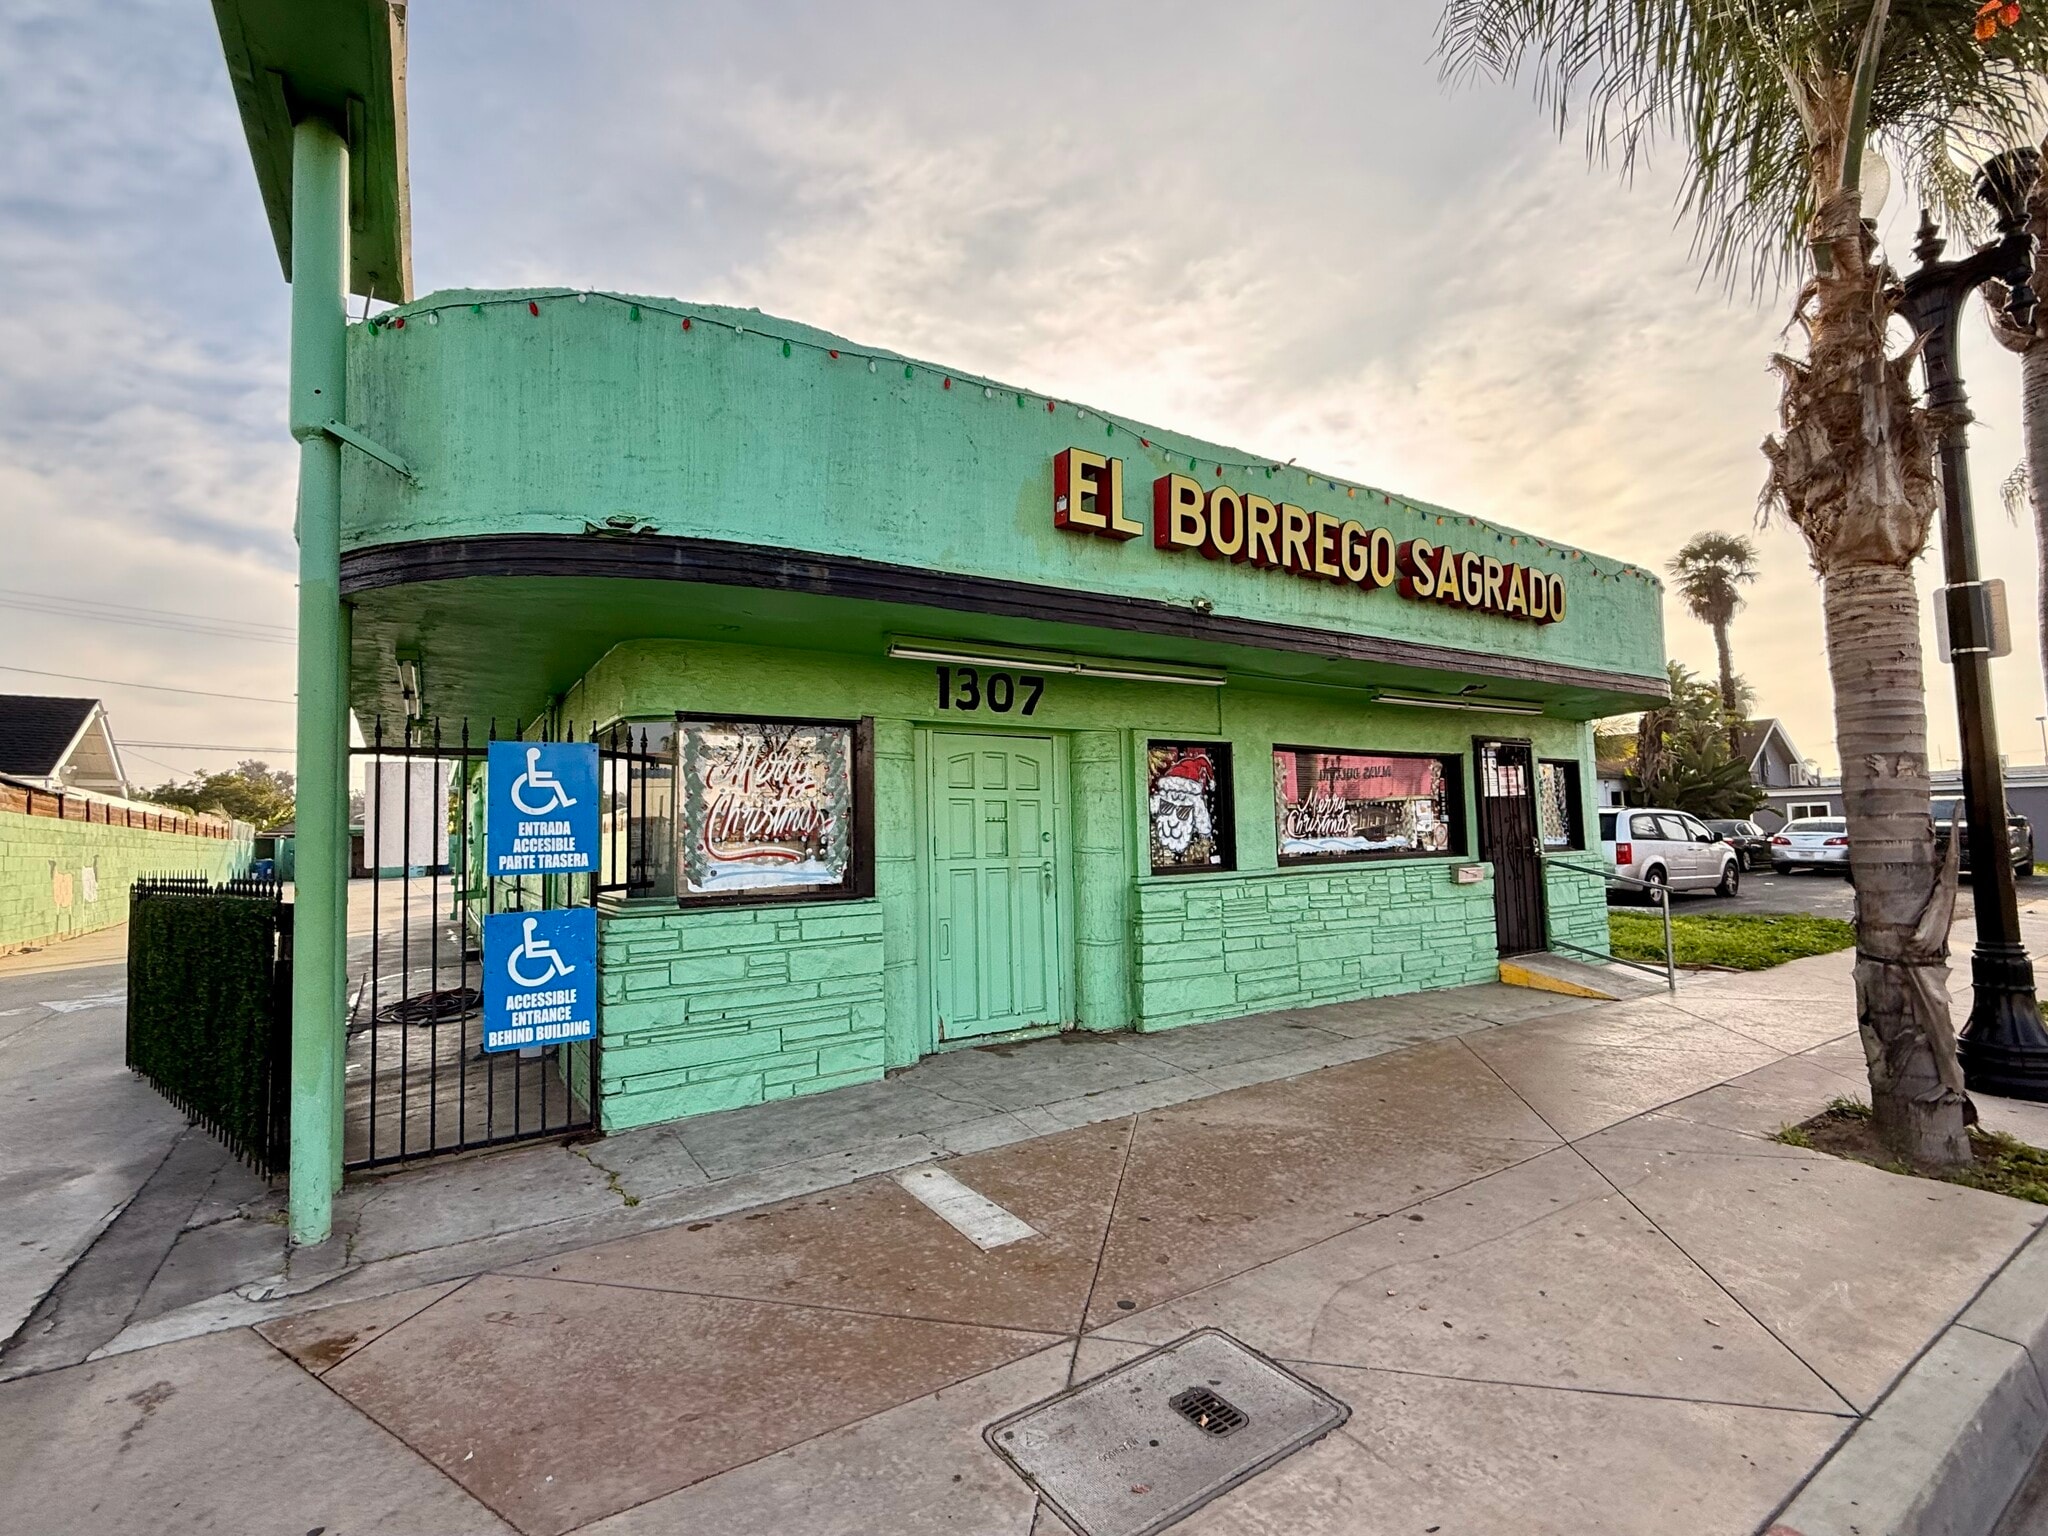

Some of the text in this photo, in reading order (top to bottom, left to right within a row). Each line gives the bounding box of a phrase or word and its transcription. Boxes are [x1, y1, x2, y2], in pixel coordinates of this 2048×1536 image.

[1066, 446, 1567, 623] EL BORREGO SAGRADO
[935, 665, 1045, 717] 1307
[706, 737, 817, 797] Merry
[1296, 786, 1350, 816] Merry
[518, 820, 572, 836] ENTRADA
[705, 793, 836, 862] Christmas
[1287, 809, 1358, 838] Christmas
[512, 837, 576, 853] ACCESIBLE
[498, 852, 589, 870] PARTE TRASERA
[505, 988, 577, 1011] ACCESSIBLE
[511, 1005, 572, 1027] ENTRANCE
[488, 1019, 591, 1048] BEHIND BUILDING
